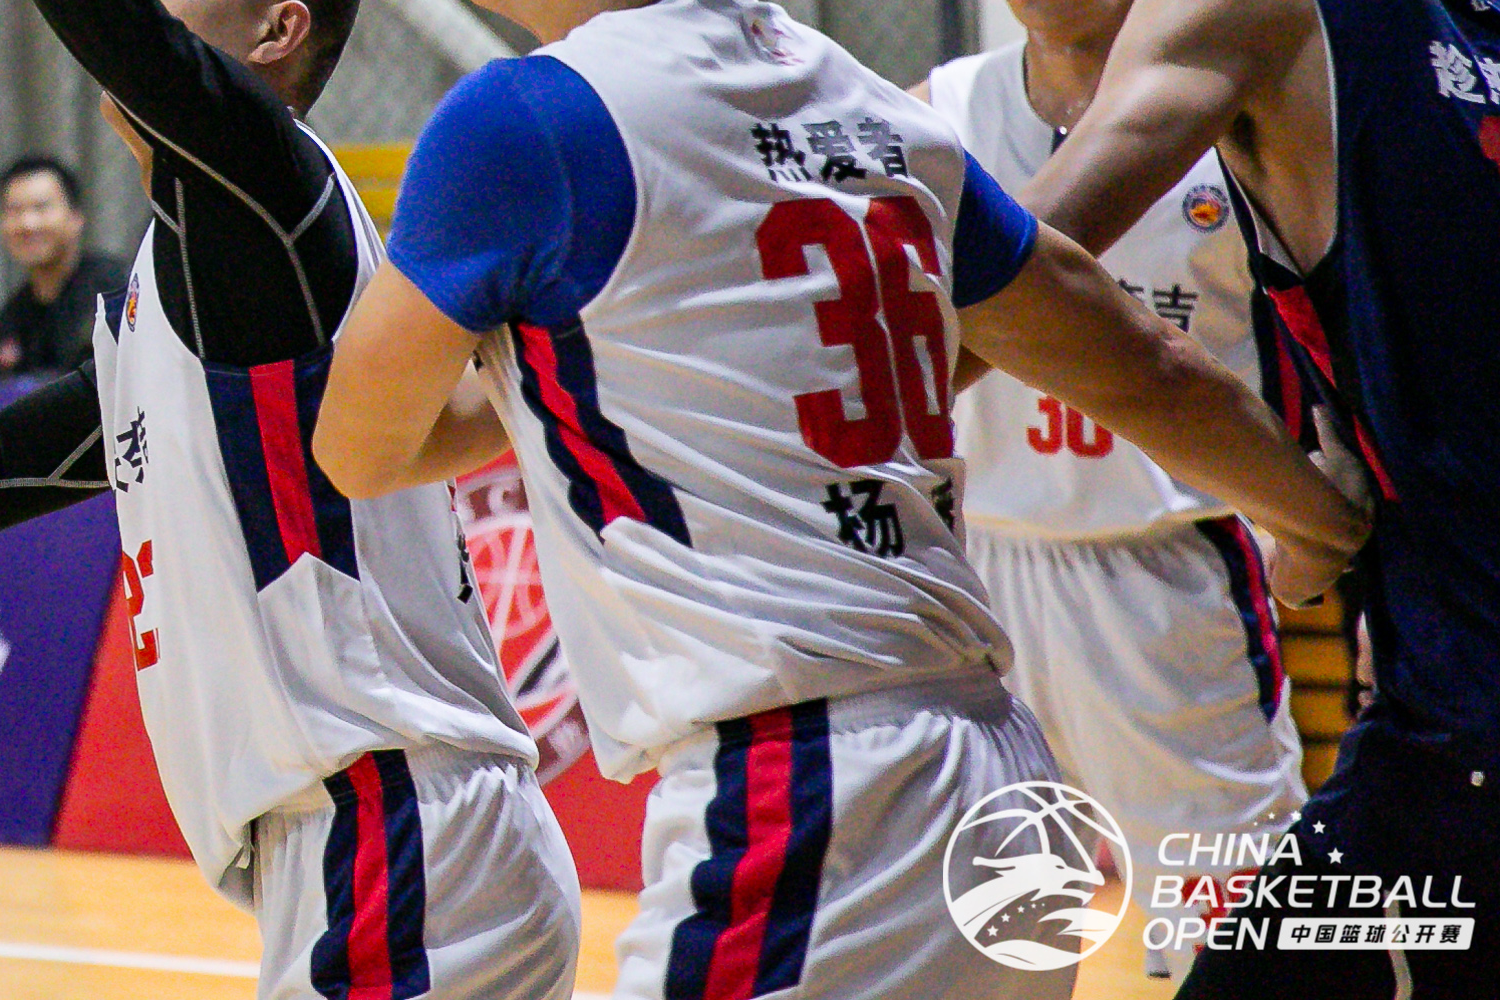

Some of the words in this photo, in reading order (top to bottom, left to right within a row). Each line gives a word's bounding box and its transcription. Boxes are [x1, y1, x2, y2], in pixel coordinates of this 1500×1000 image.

[751, 116, 910, 183] 热爱者
[755, 195, 956, 468] 36
